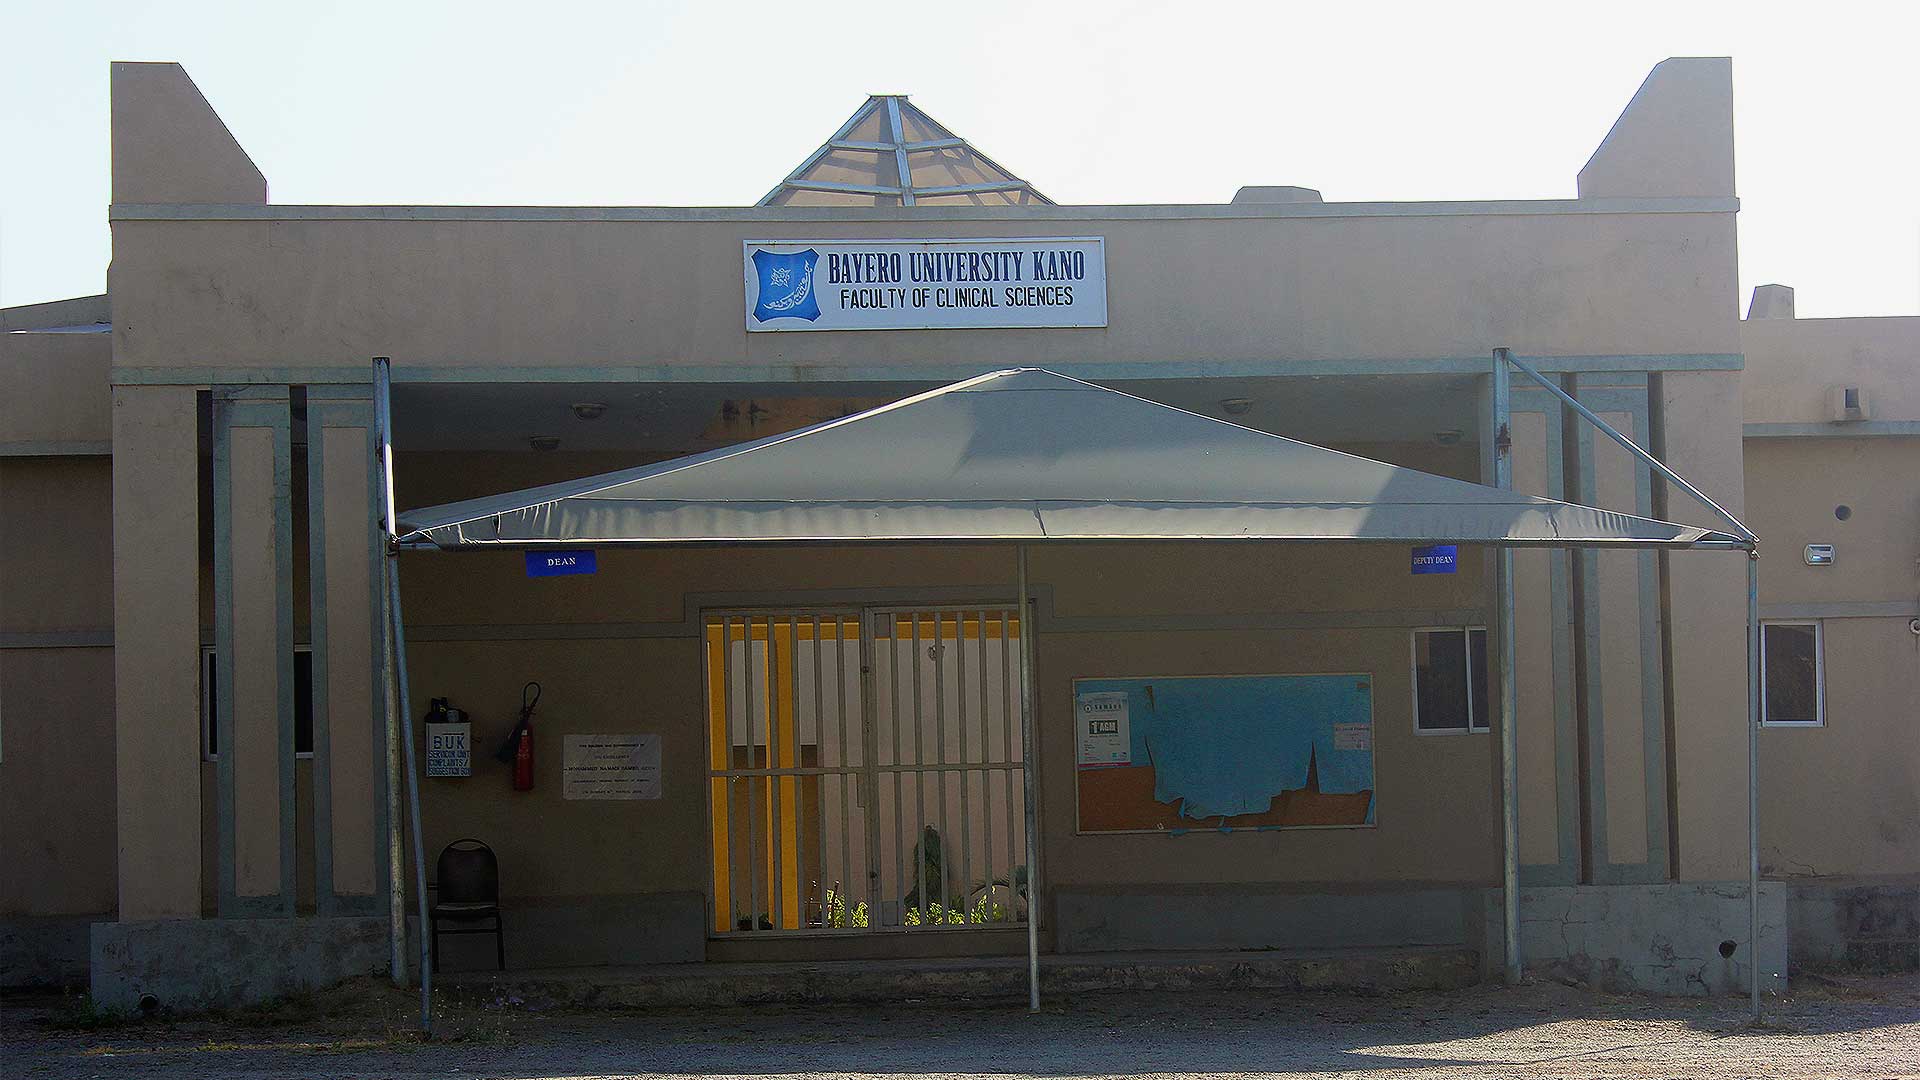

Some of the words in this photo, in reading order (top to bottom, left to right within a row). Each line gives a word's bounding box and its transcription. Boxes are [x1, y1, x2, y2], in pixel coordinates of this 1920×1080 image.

[828, 252, 901, 284] BAYERO
[909, 251, 1024, 283] UNIVERSITY
[1032, 250, 1085, 281] KANO
[840, 288, 907, 309] FACULTY
[912, 288, 931, 308] OF
[936, 287, 999, 308] CLINICAL
[1005, 286, 1074, 307] SCIENCES
[547, 557, 576, 567] DEAN
[1413, 556, 1434, 565] DEPUTY
[1435, 555, 1453, 564] DEAN
[433, 735, 465, 750] BUK
